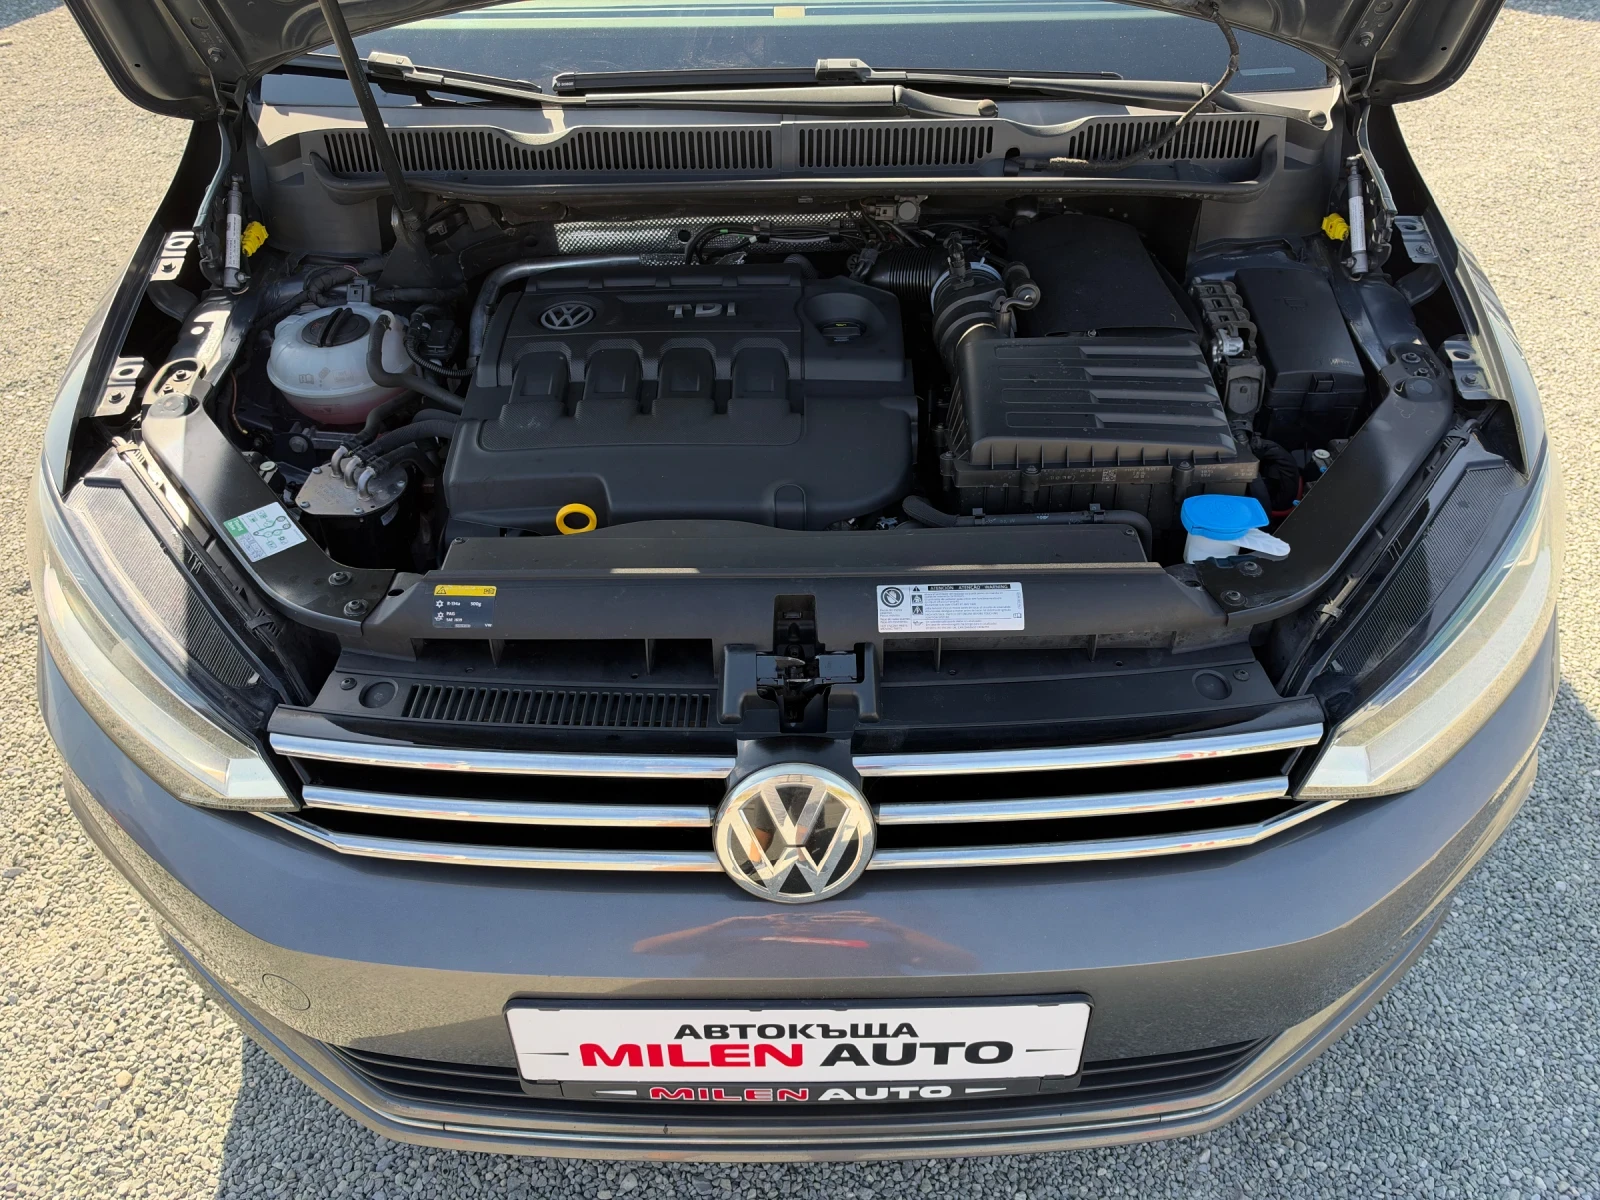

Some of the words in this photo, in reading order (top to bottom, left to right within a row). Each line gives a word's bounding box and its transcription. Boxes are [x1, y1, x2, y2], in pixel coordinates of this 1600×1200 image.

[667, 302, 736, 318] TDI
[579, 1043, 803, 1067] MILEN
[819, 1040, 1014, 1067] AUTO
[649, 1086, 809, 1101] MILEN
[818, 1085, 952, 1101] AUTO
